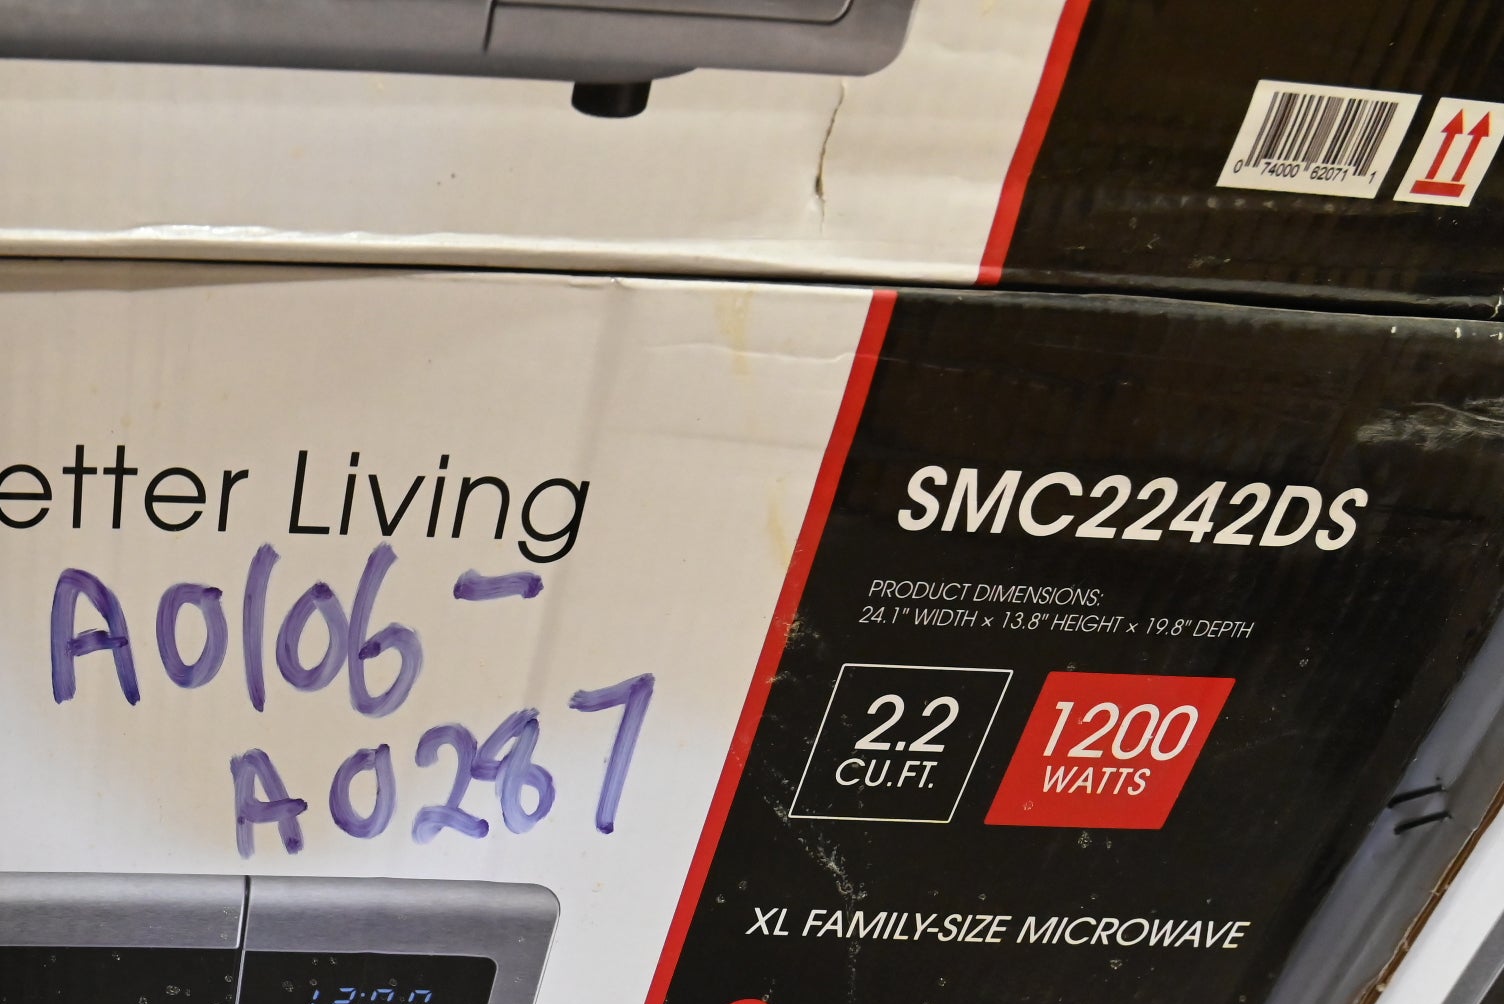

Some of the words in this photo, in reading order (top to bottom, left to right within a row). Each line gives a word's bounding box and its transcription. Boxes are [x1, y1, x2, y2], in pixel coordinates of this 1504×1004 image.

[1232, 158, 1244, 175] 0
[1259, 160, 1301, 179] 74000
[1309, 165, 1350, 184] 62071
[1368, 170, 1378, 185] 1
[288, 450, 590, 564] Living
[897, 465, 1367, 551] SMC2242DS
[868, 579, 972, 602] PRODUCT
[973, 583, 1105, 607] DIMENSIONS:
[914, 607, 977, 627] WIDTH
[1050, 613, 1125, 634] HEIGHT
[1193, 619, 1255, 639] DEPTH
[854, 693, 960, 754] 2.2
[1041, 701, 1199, 762] 1200
[229, 672, 655, 859] A0287
[835, 759, 938, 788] CU.FT.
[1042, 765, 1151, 796] WATTS
[745, 907, 791, 936] XL
[802, 909, 1012, 943] FAMILY-SIZE
[1016, 916, 1251, 950] MICROWAVE
